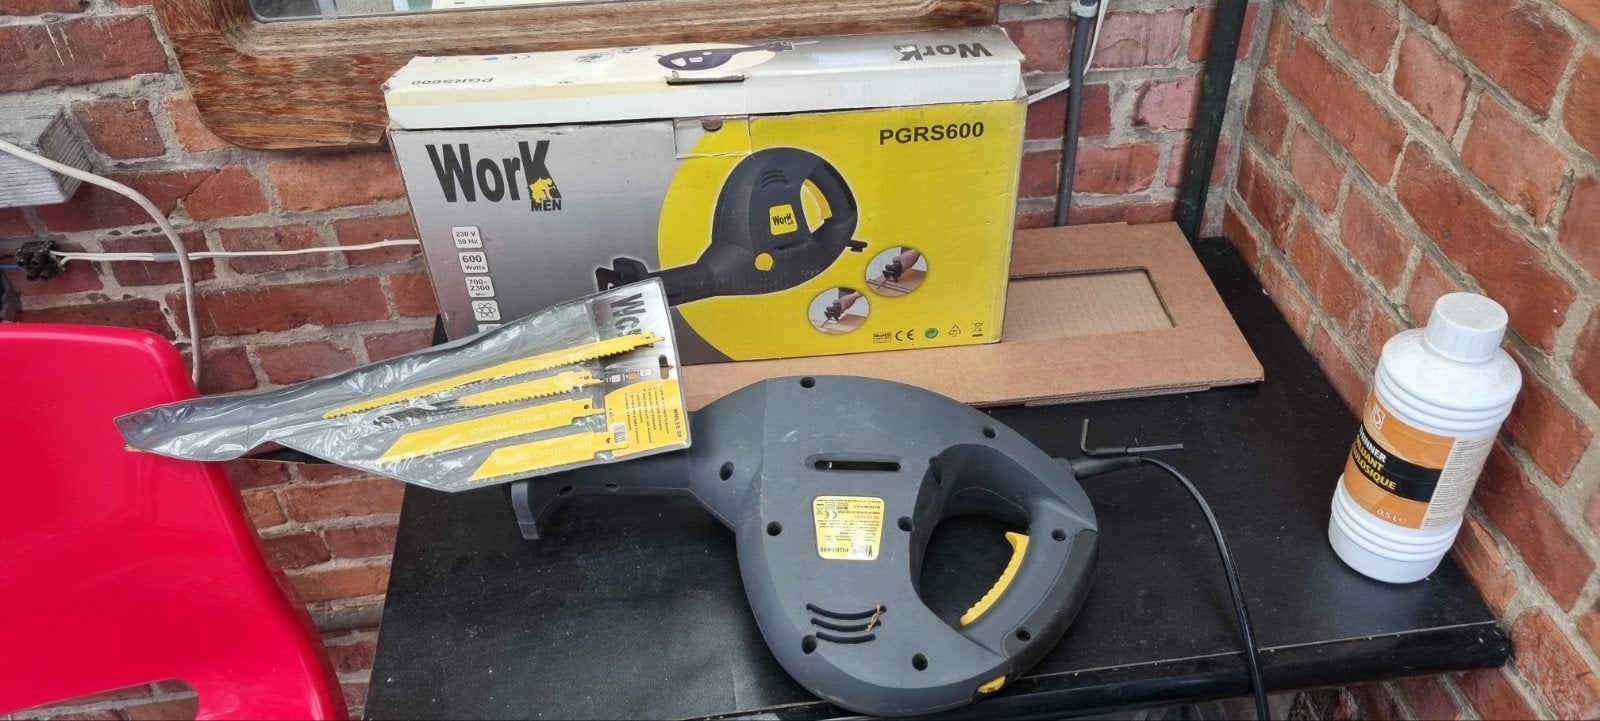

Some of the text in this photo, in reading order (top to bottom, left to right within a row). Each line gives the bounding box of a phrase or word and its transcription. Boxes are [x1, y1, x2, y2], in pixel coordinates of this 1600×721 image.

[879, 121, 985, 146] PGRS600
[425, 140, 562, 203] WorK
[531, 199, 562, 212] MEN
[462, 254, 482, 263] 600
